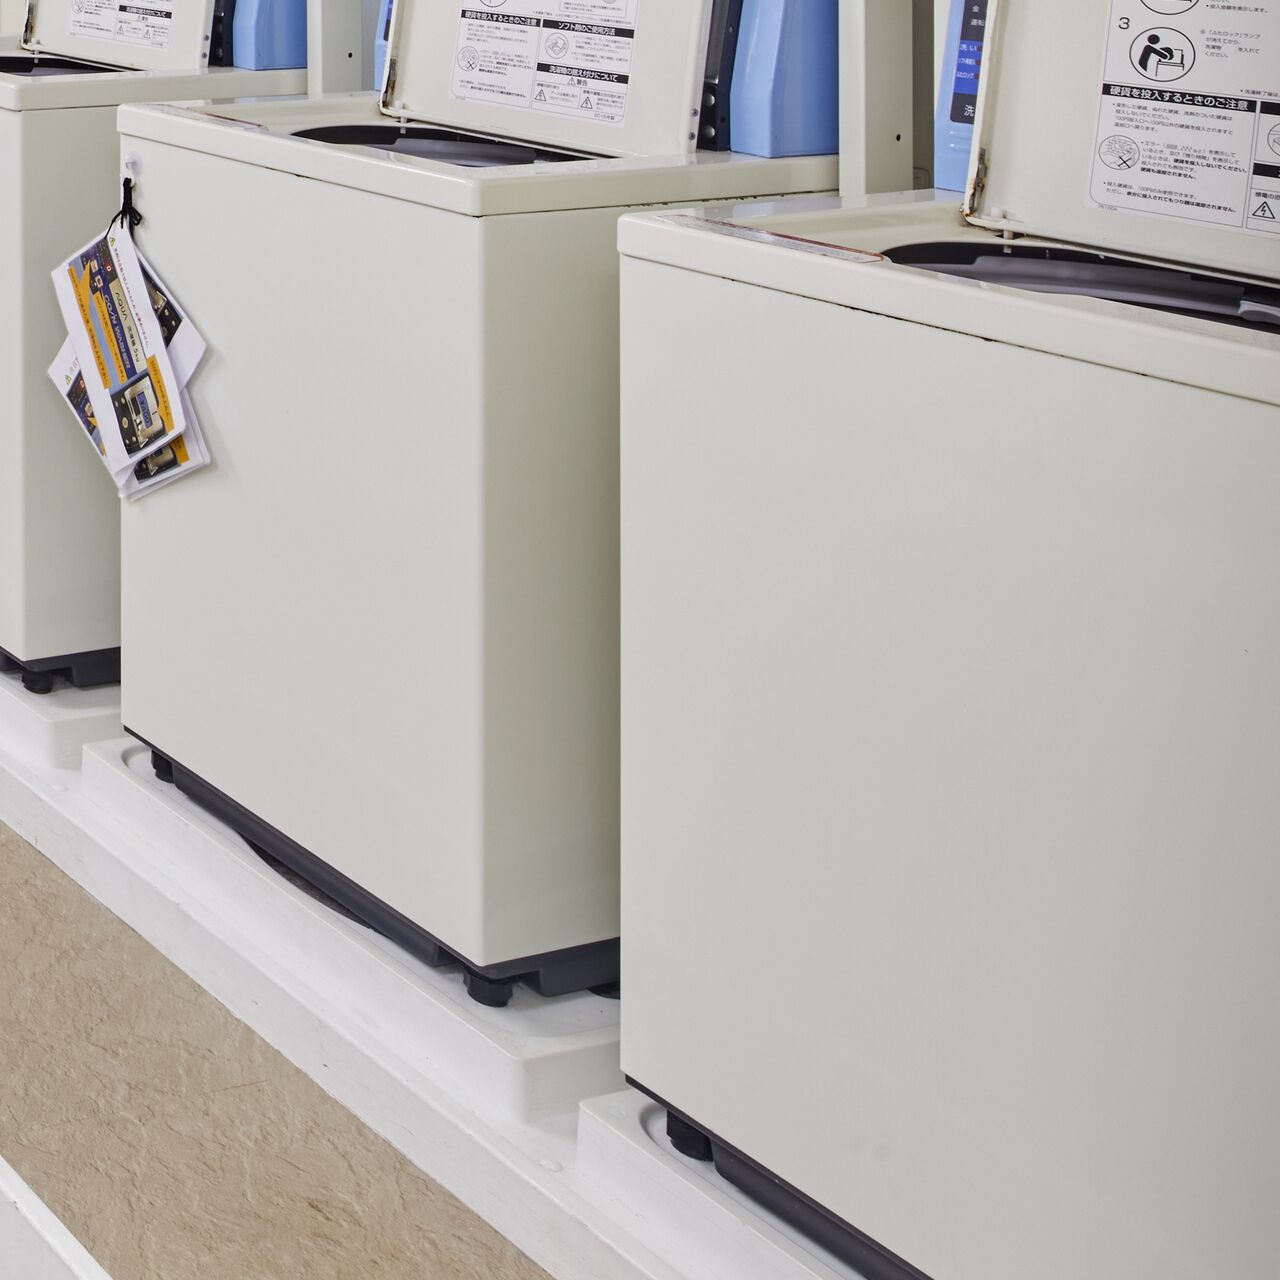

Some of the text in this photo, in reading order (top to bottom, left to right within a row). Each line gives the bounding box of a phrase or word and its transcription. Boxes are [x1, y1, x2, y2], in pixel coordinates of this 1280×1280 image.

[1118, 17, 1130, 29] 3
[1110, 86, 1248, 110] 硬貨を投入するときのご注意
